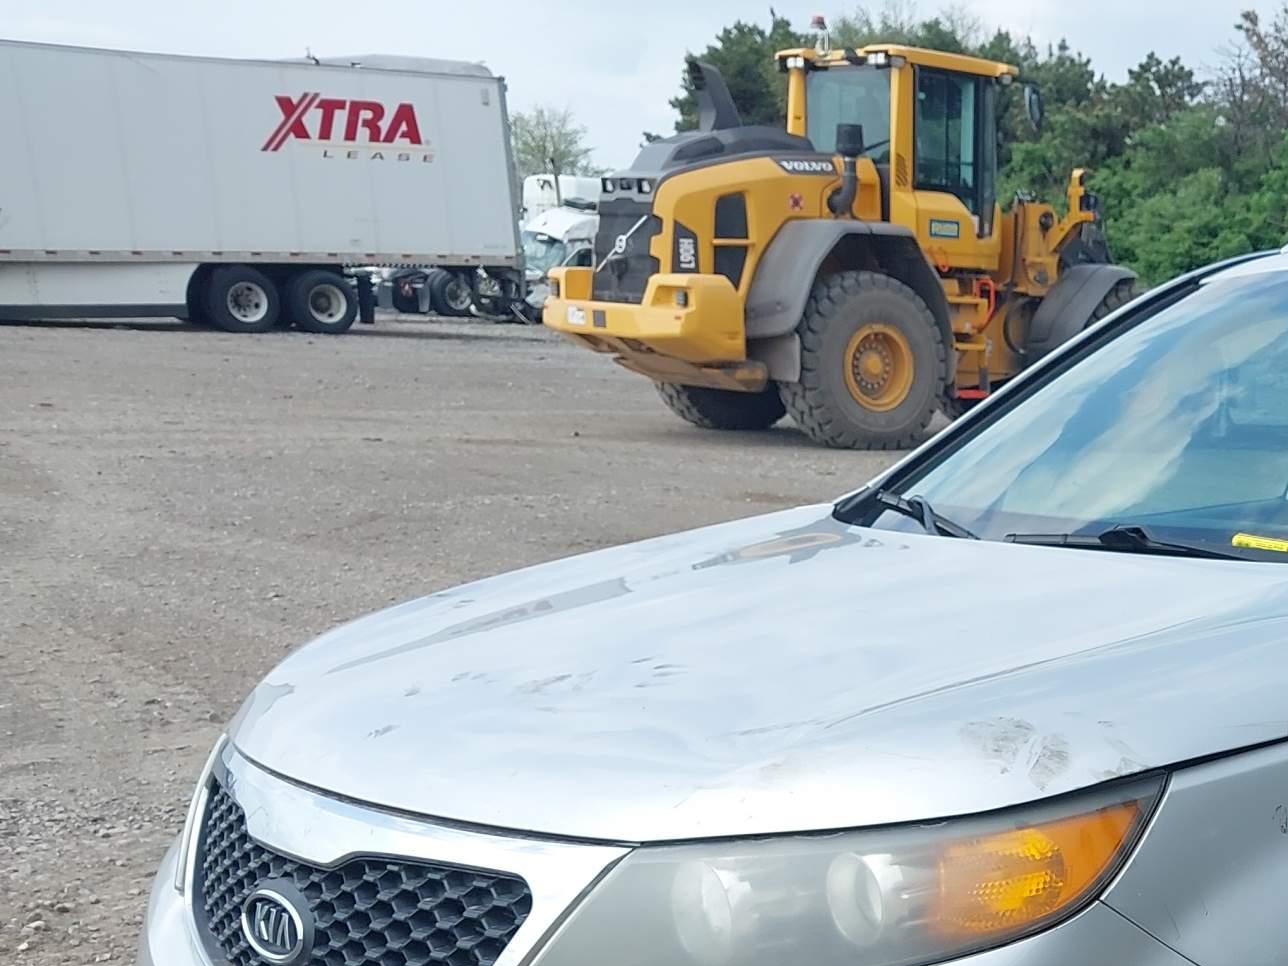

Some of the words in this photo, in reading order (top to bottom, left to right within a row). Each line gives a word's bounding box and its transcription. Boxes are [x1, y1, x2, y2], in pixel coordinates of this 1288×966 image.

[261, 92, 423, 151] XTRA
[323, 150, 434, 163] LEASE
[780, 160, 833, 171] VOLVO
[254, 902, 291, 951] KIA
